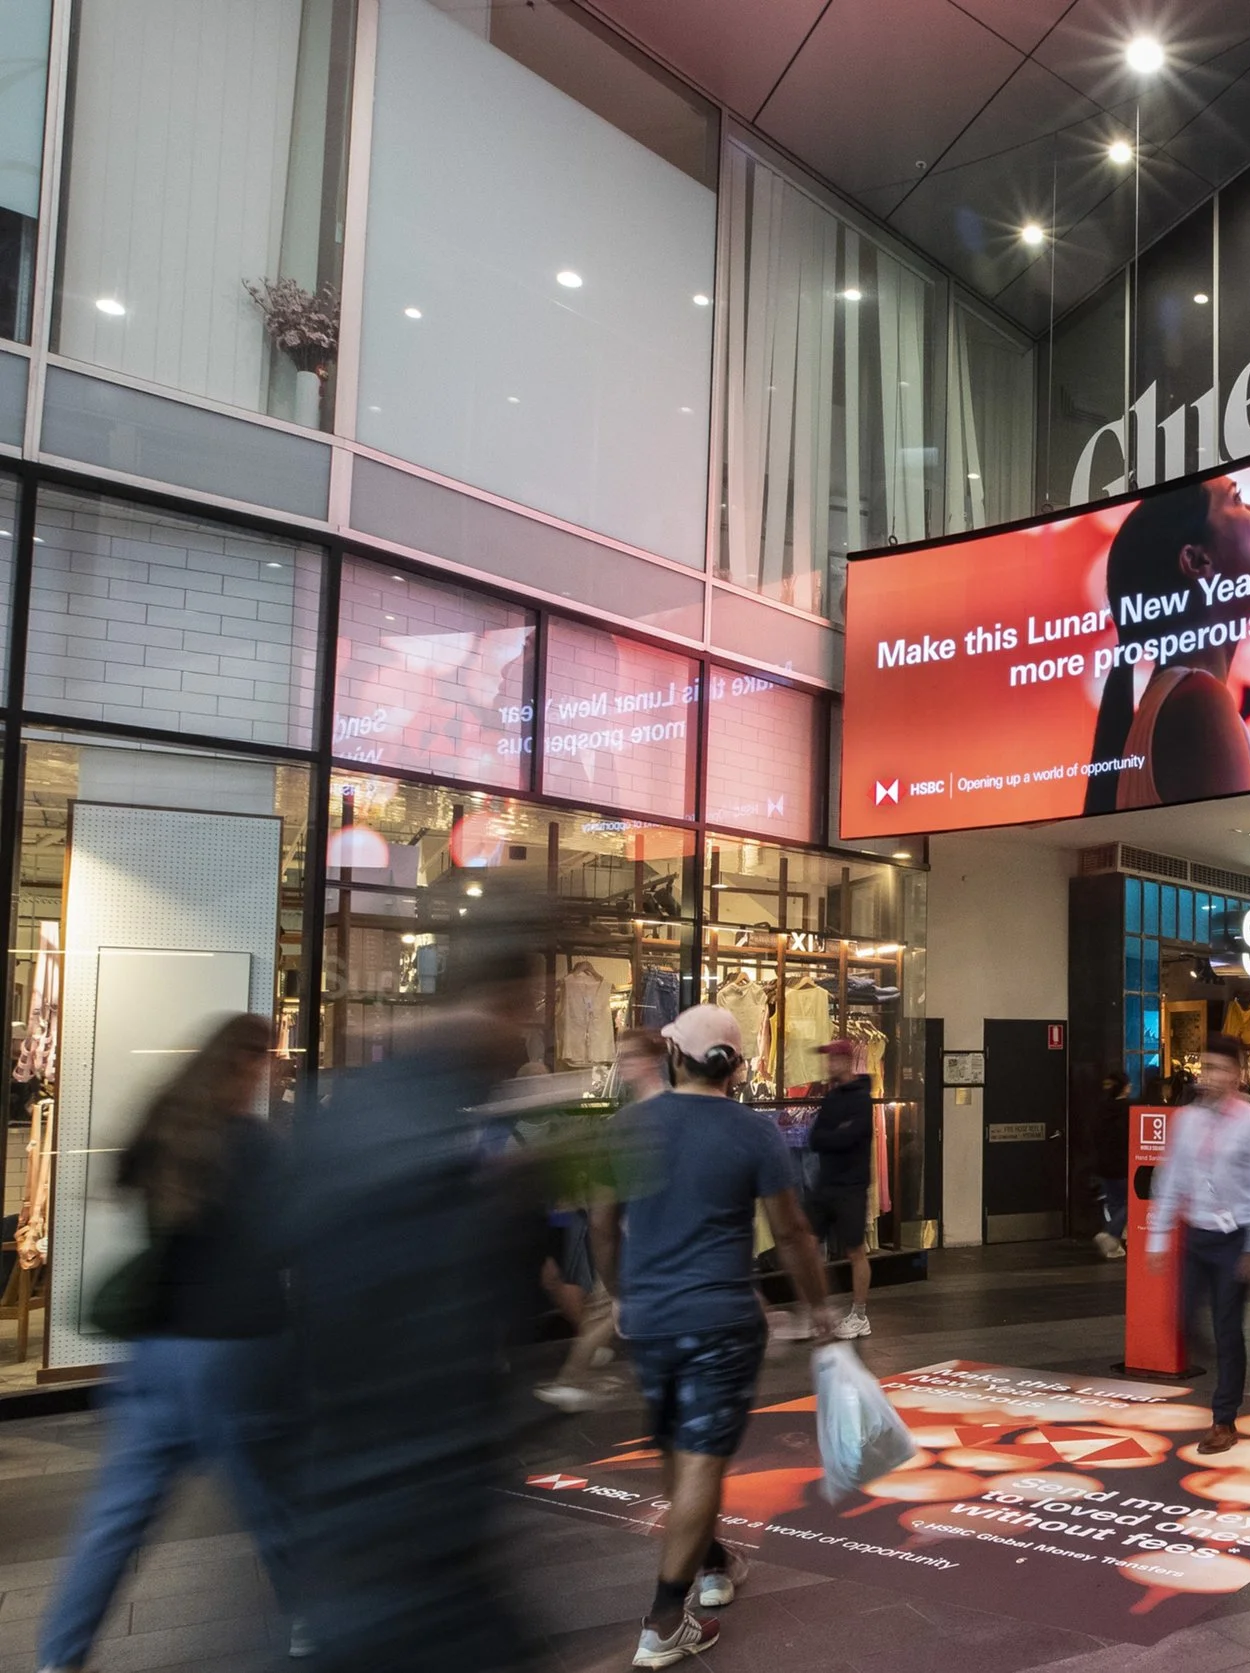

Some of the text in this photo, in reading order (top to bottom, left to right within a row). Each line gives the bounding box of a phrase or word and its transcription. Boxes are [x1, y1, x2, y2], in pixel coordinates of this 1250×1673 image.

[877, 638, 956, 669] Make
[964, 624, 1018, 655] this
[1027, 610, 1111, 645] Lunar
[1119, 589, 1189, 626] New
[1009, 652, 1084, 687] more
[910, 755, 1145, 797] HSBC Opening up a world of opportunity
[880, 1382, 1048, 1409] prosperous
[909, 1375, 1131, 1410] New Year more
[934, 1369, 1167, 1403] Make this Lunar
[980, 1489, 1023, 1503] to
[1029, 1499, 1150, 1528] loved
[1012, 1477, 1120, 1503] Send
[583, 1485, 641, 1502] HSBC
[721, 1516, 749, 1525] up
[765, 1523, 817, 1541] world
[818, 1536, 845, 1547] of
[842, 1541, 959, 1571] opportunity
[949, 1503, 1117, 1541] without
[924, 1521, 1185, 1578] HSBC Global Money Transfers
